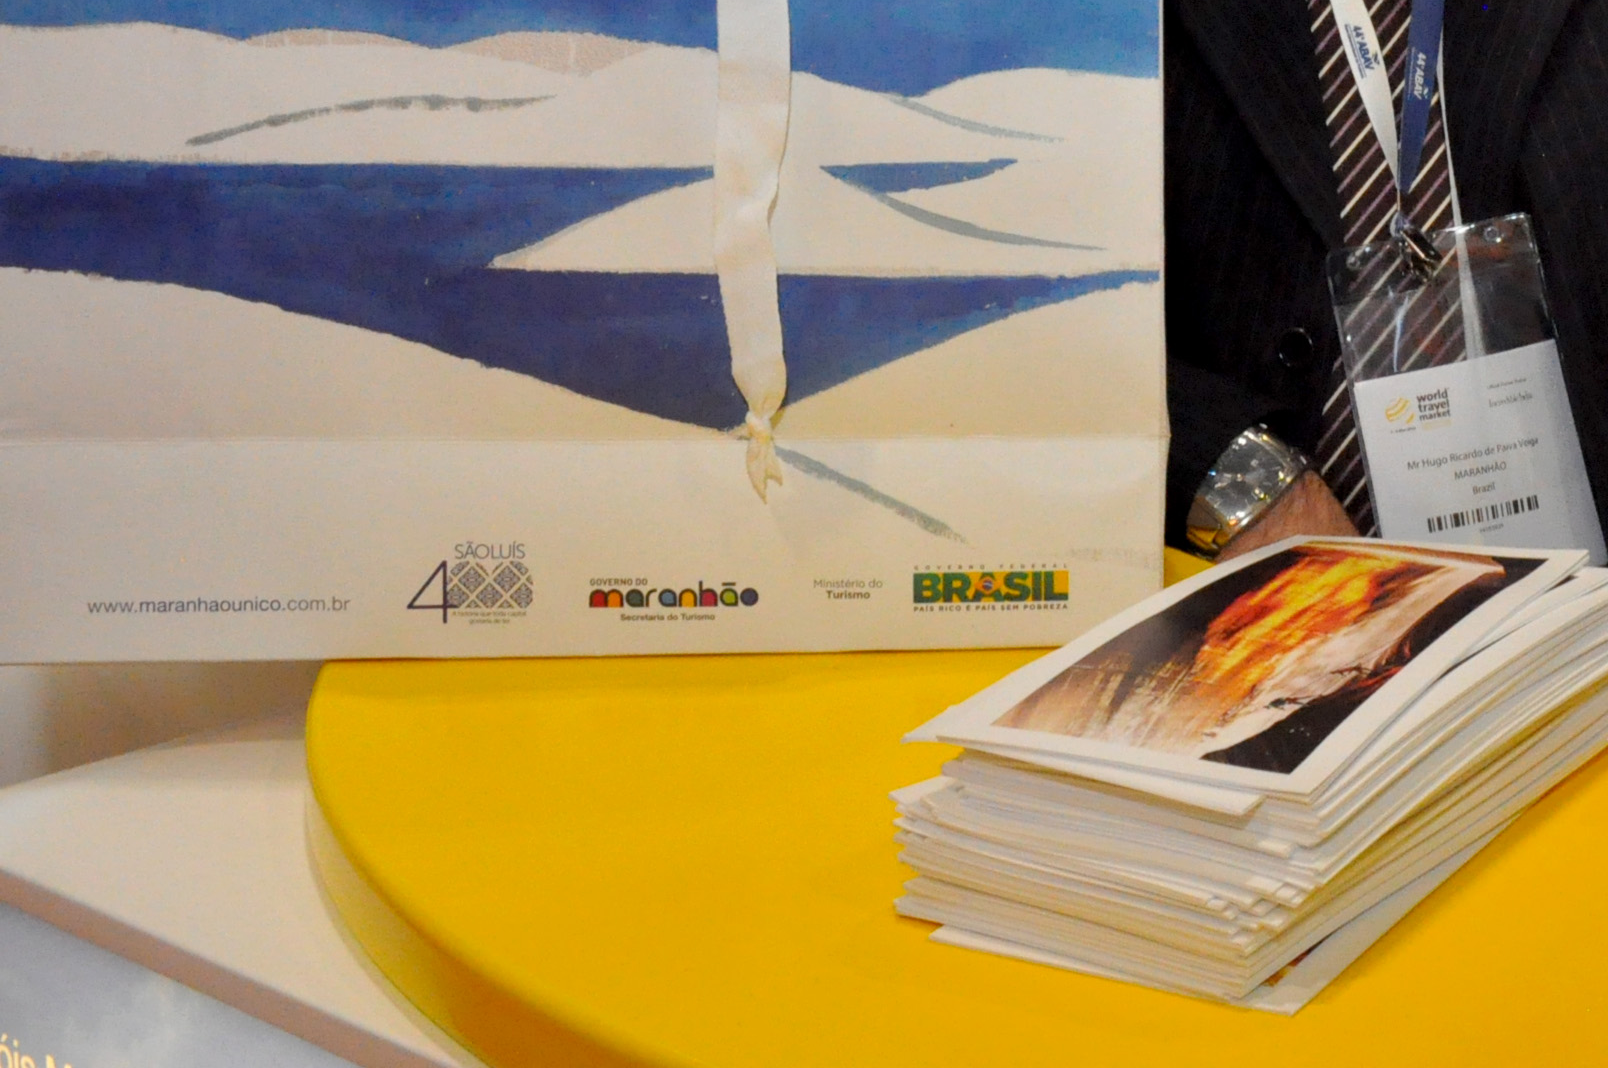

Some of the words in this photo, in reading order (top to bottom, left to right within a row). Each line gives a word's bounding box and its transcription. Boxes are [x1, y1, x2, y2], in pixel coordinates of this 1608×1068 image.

[1416, 388, 1448, 403] world
[1418, 399, 1449, 412] travel
[1419, 410, 1451, 421] market
[1407, 461, 1419, 470] Mr
[1422, 457, 1448, 468] Hugo
[1450, 449, 1483, 462] Ricardo
[1484, 447, 1495, 456] de
[1454, 461, 1507, 480] MARANHÃO
[1472, 482, 1496, 495] Brazil
[589, 578, 633, 586] GOVERNO
[635, 578, 648, 586] DO
[813, 578, 865, 589] Ministério
[868, 578, 883, 588] do
[913, 570, 1069, 603] BRASIL
[589, 580, 759, 607] maranhão
[826, 590, 870, 599] Turismo
[88, 596, 350, 613] www.maranhaounico.com.br
[913, 604, 934, 612] PAÍS
[976, 603, 996, 611] PAÍS
[620, 613, 664, 621] Secretaria
